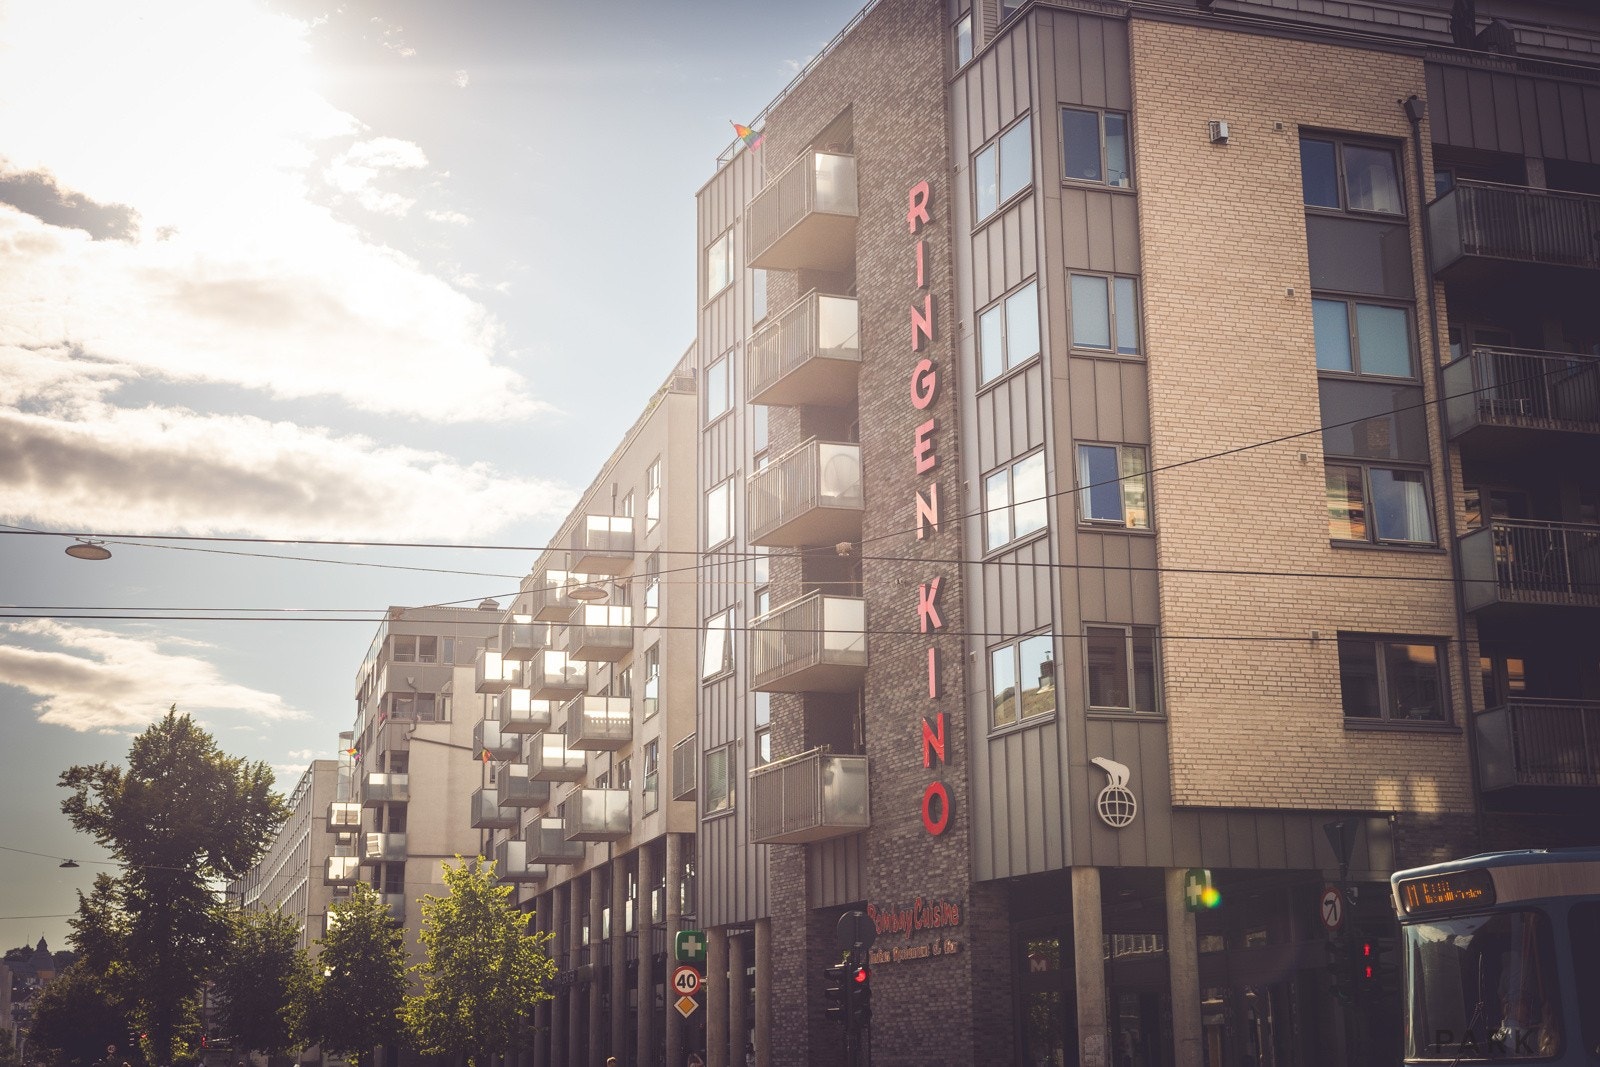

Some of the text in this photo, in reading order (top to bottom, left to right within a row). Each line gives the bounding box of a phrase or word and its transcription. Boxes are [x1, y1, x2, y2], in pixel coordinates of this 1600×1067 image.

[906, 180, 951, 836] RINGEN KINO
[914, 896, 959, 930] Cuisine
[676, 973, 697, 989] 40
